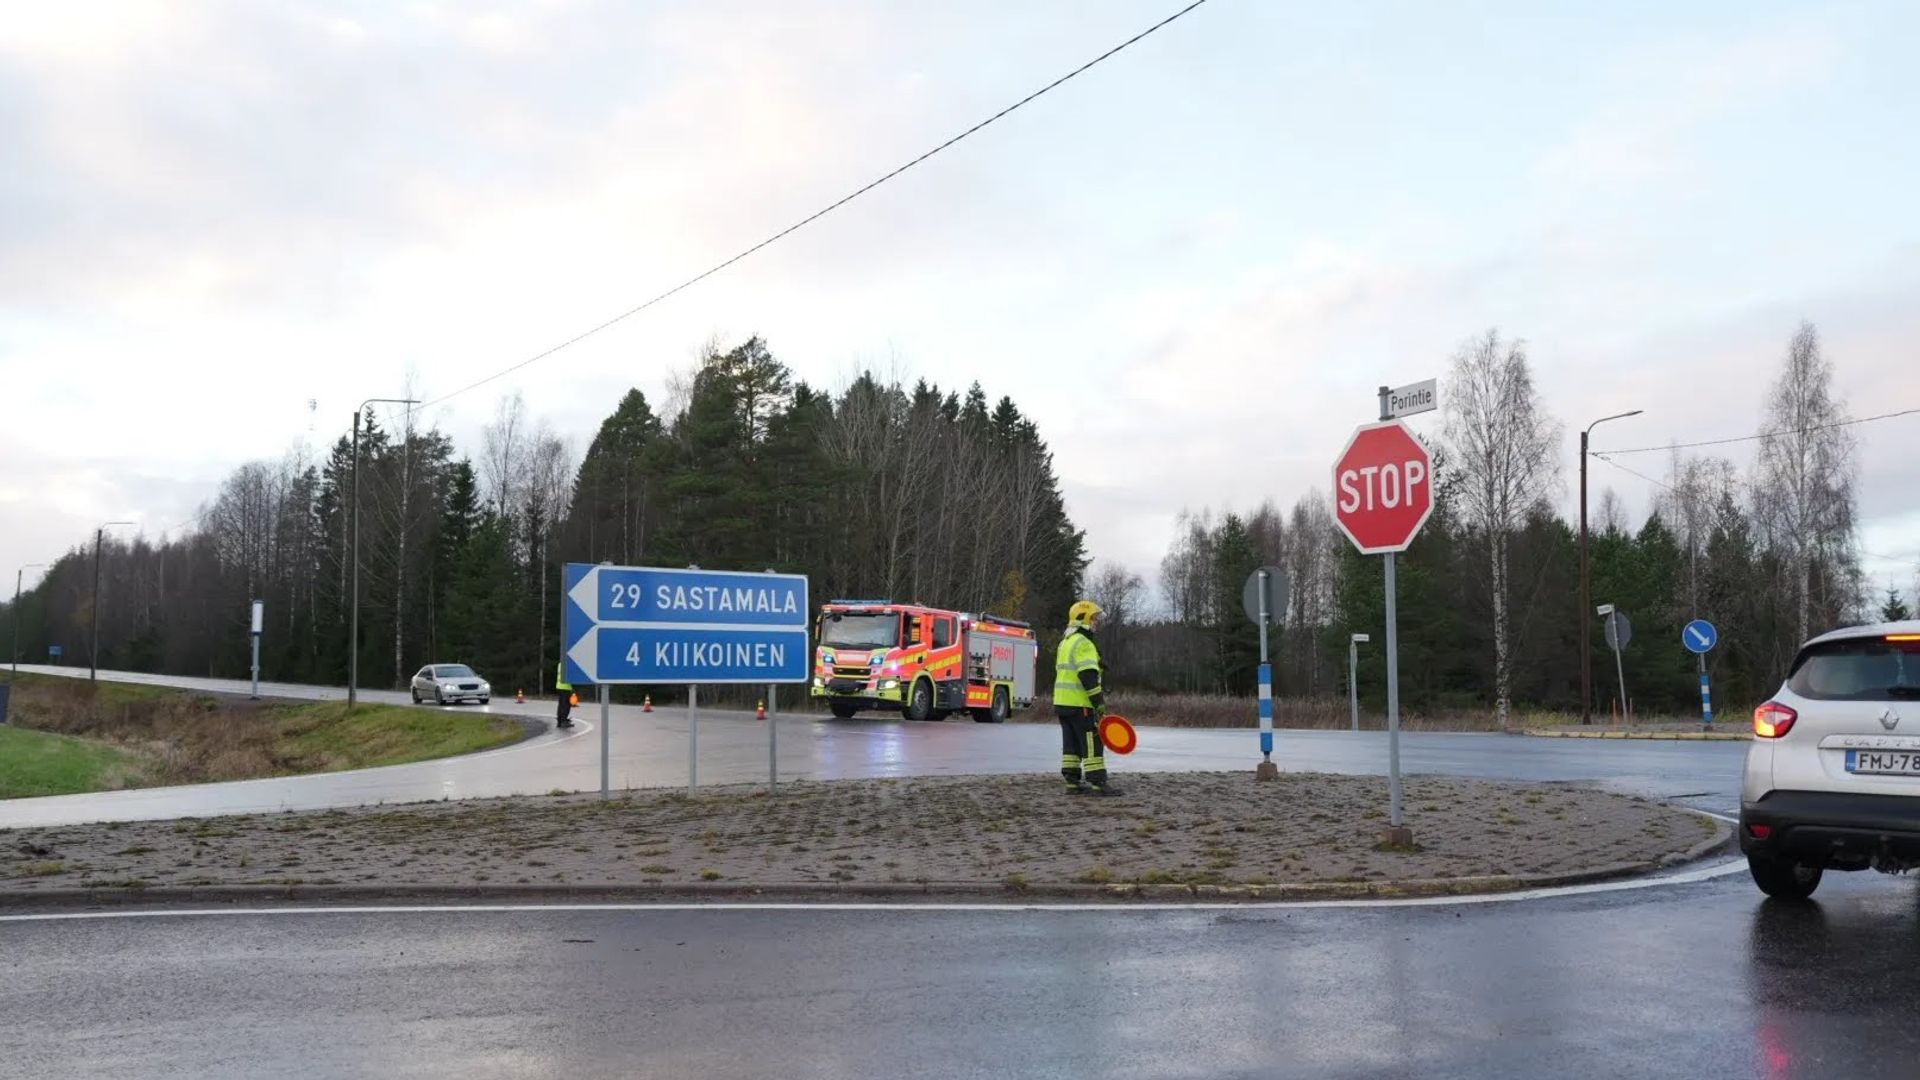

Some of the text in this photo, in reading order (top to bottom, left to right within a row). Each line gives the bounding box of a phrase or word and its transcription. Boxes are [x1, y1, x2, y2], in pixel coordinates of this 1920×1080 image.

[1391, 389, 1432, 411] Porintie
[1339, 459, 1425, 514] STOP
[610, 583, 798, 613] 29 SASTAMALA
[625, 641, 785, 667] 4 KIIKOINEN
[1859, 753, 1920, 770] FMJ-78
